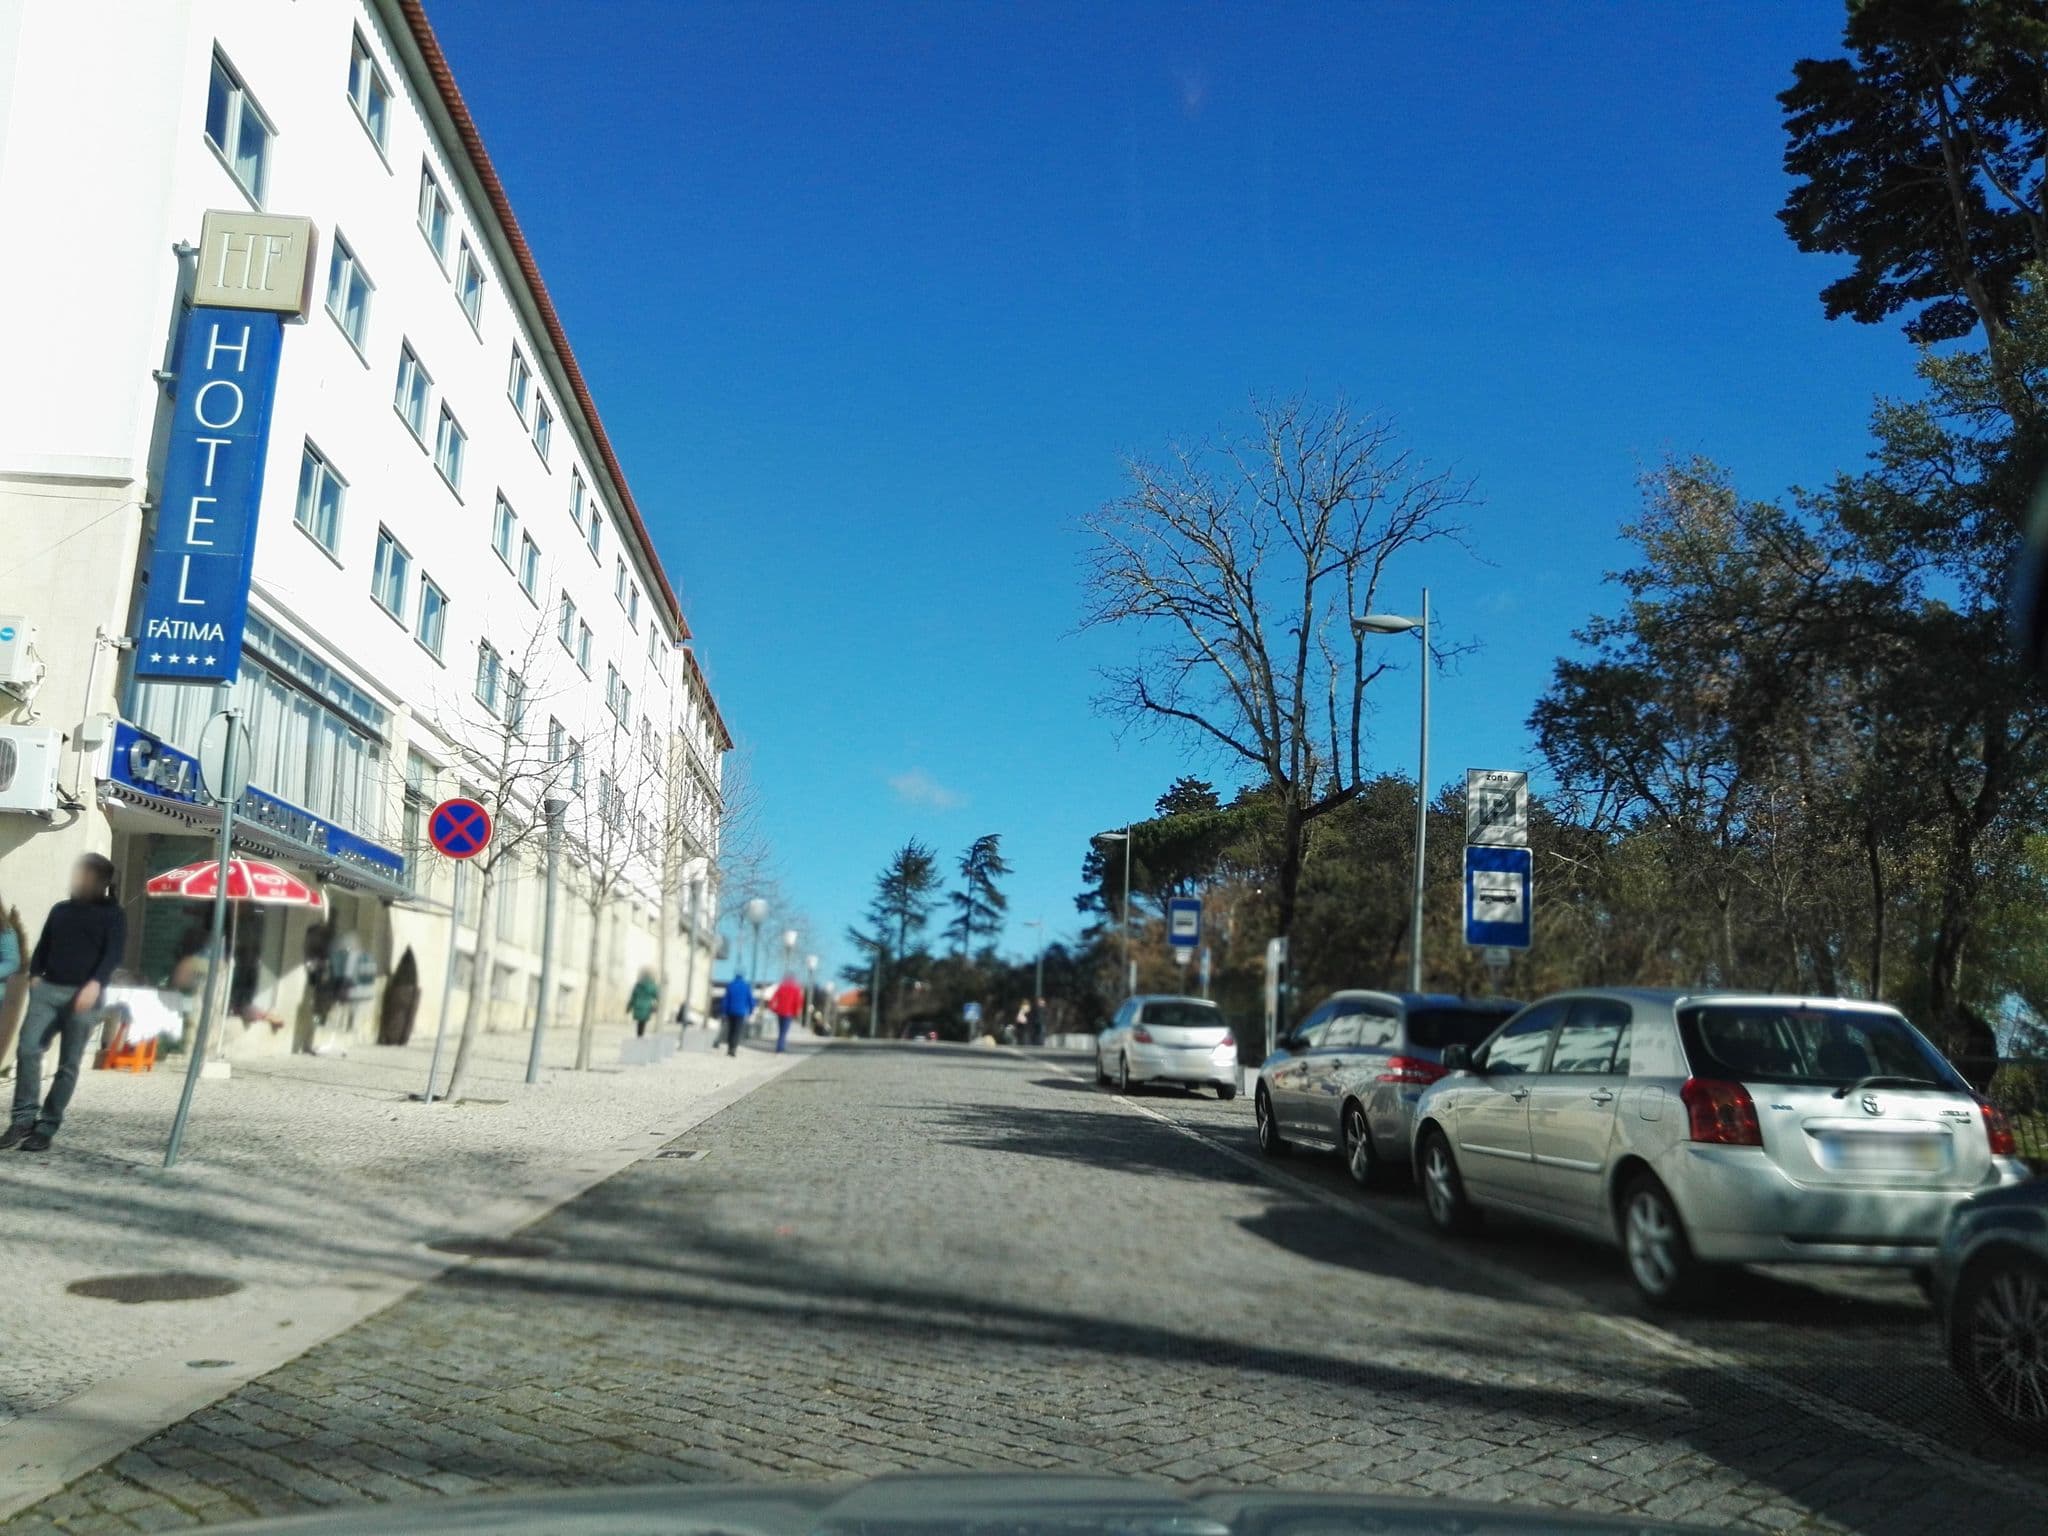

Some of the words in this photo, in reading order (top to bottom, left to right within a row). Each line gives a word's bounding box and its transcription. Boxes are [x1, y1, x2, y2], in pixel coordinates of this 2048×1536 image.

[211, 230, 294, 292] HF
[178, 323, 251, 605] HOTEL
[147, 616, 225, 642] FÁTIMA
